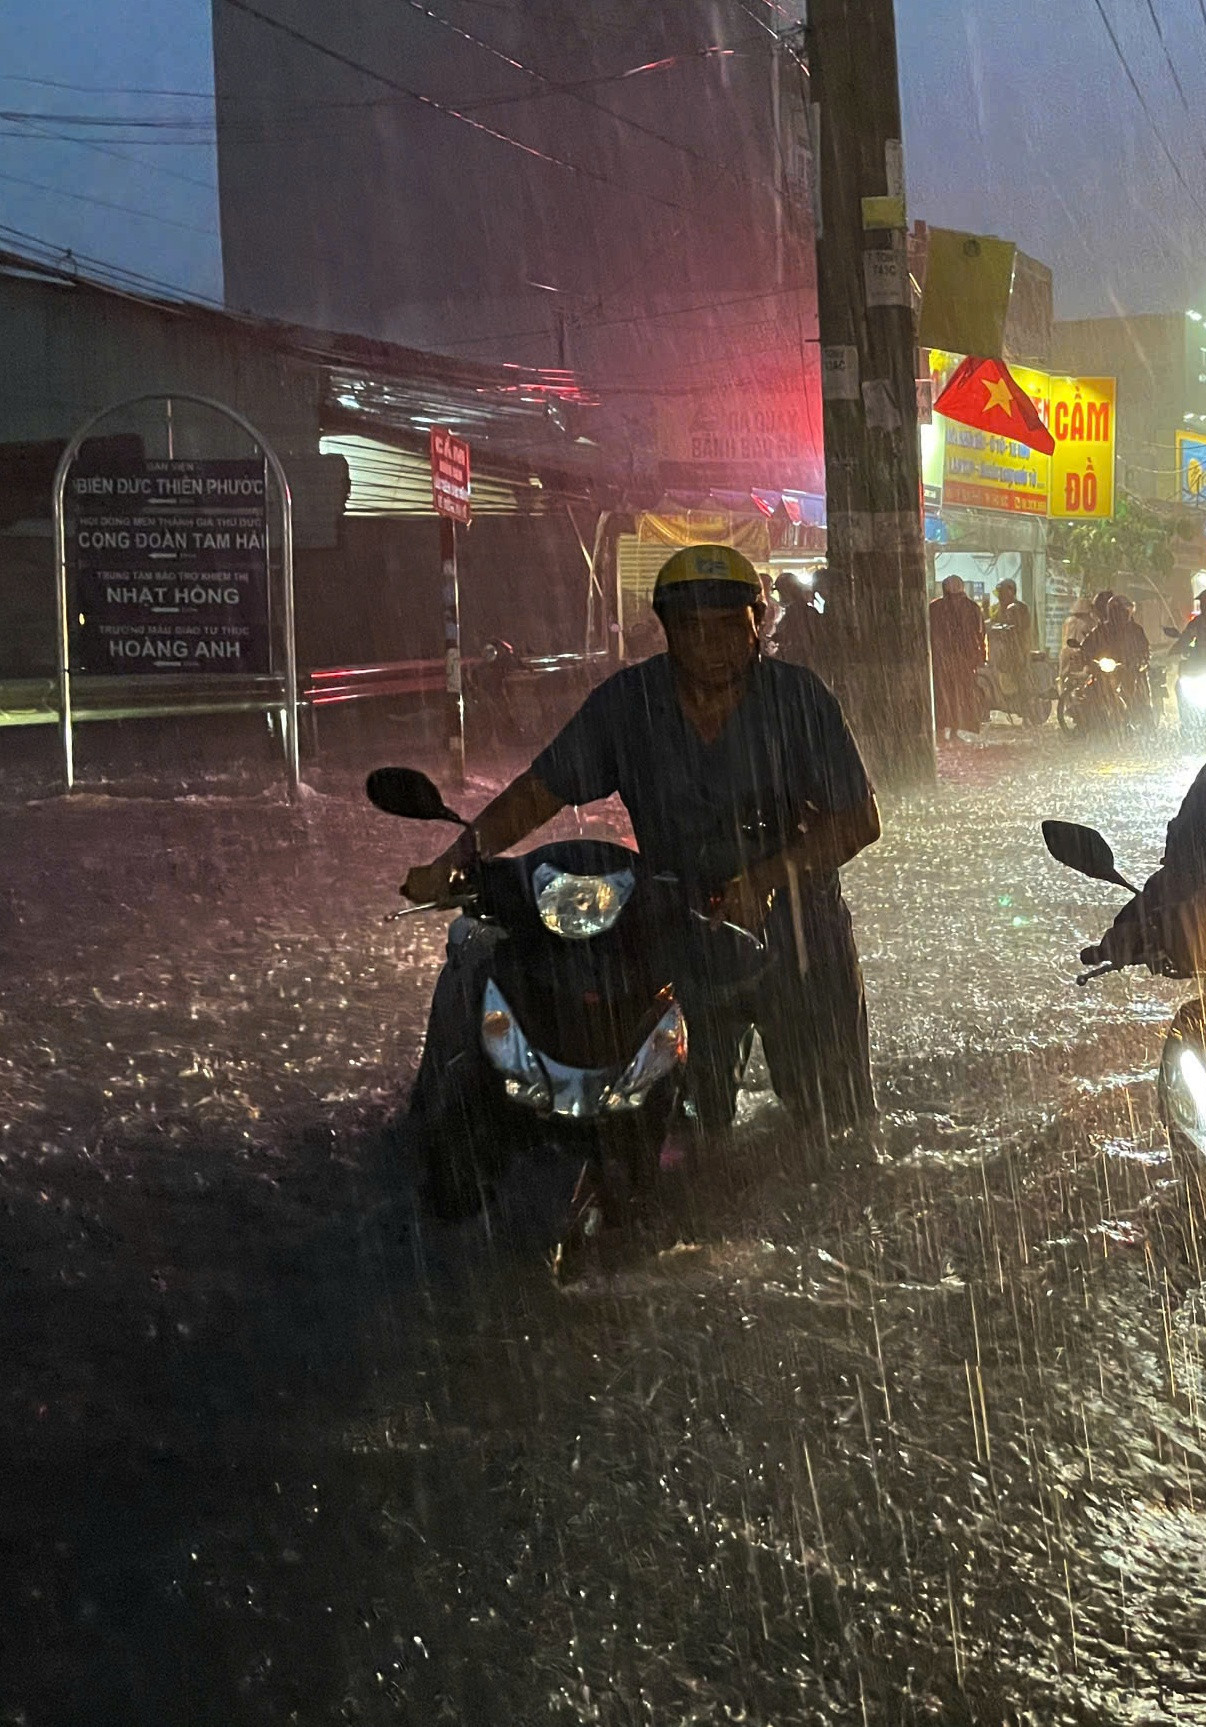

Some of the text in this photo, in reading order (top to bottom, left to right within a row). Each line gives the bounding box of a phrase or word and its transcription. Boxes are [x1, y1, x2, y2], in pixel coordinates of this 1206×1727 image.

[1055, 386, 1109, 441] CẦM
[1064, 457, 1097, 512] ĐỒ
[192, 533, 230, 549] TAM
[109, 636, 241, 658] HOÀNG ANH
